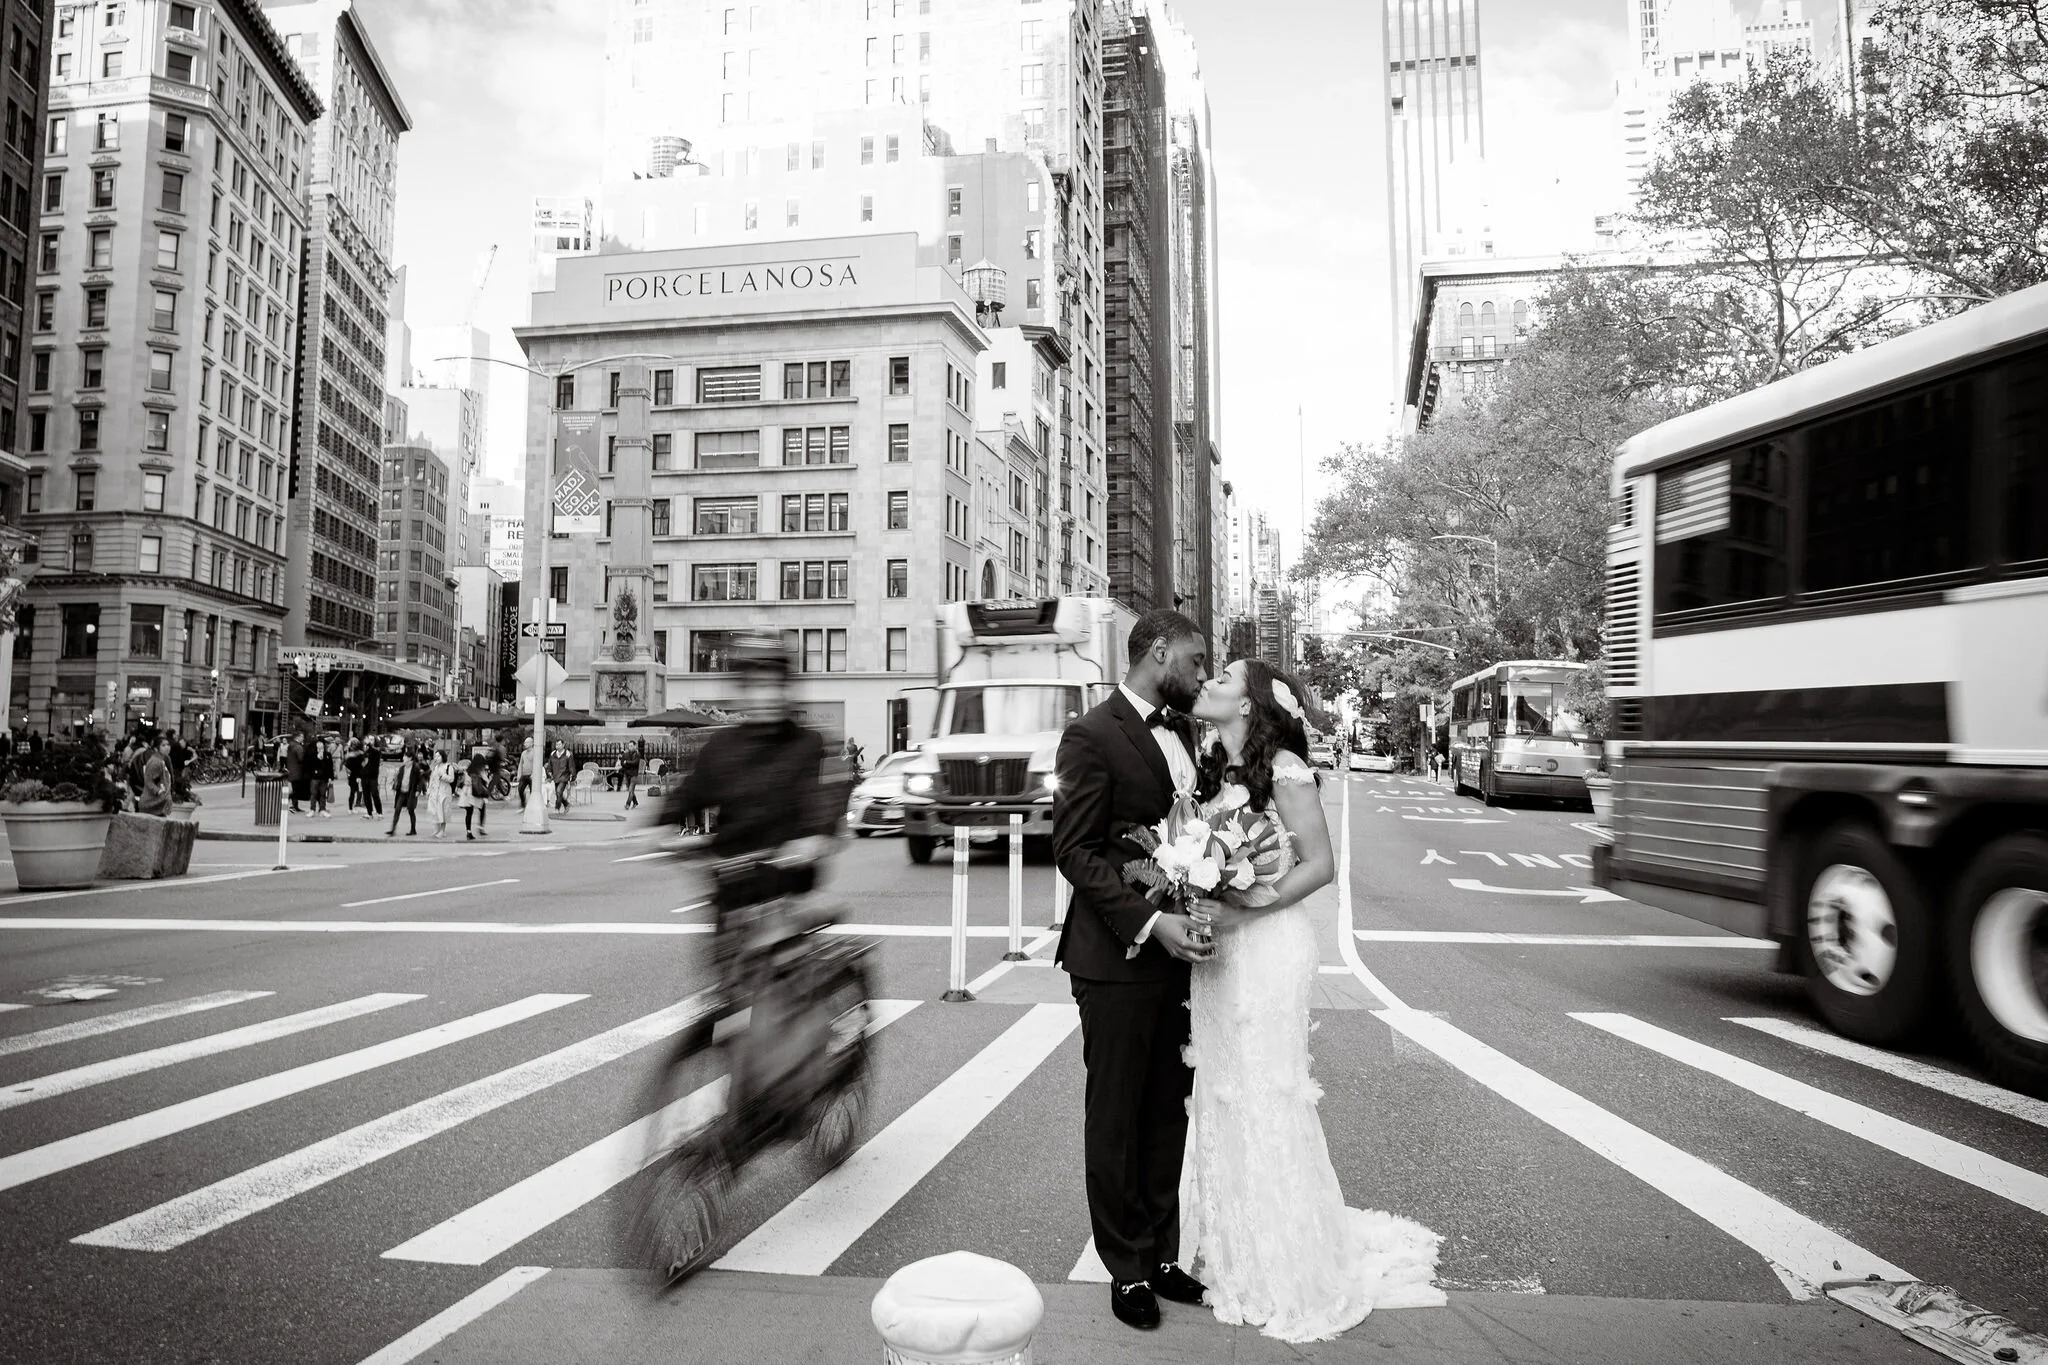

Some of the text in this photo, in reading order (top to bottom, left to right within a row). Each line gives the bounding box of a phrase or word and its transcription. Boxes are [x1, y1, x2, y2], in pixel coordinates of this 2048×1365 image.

[608, 263, 858, 301] PORCELANOSA
[555, 477, 580, 502] MAD.
[564, 495, 583, 512] SQ.
[547, 626, 561, 634] WAY
[1376, 805, 1484, 815] ONLY
[1420, 849, 1594, 869] ONLY
